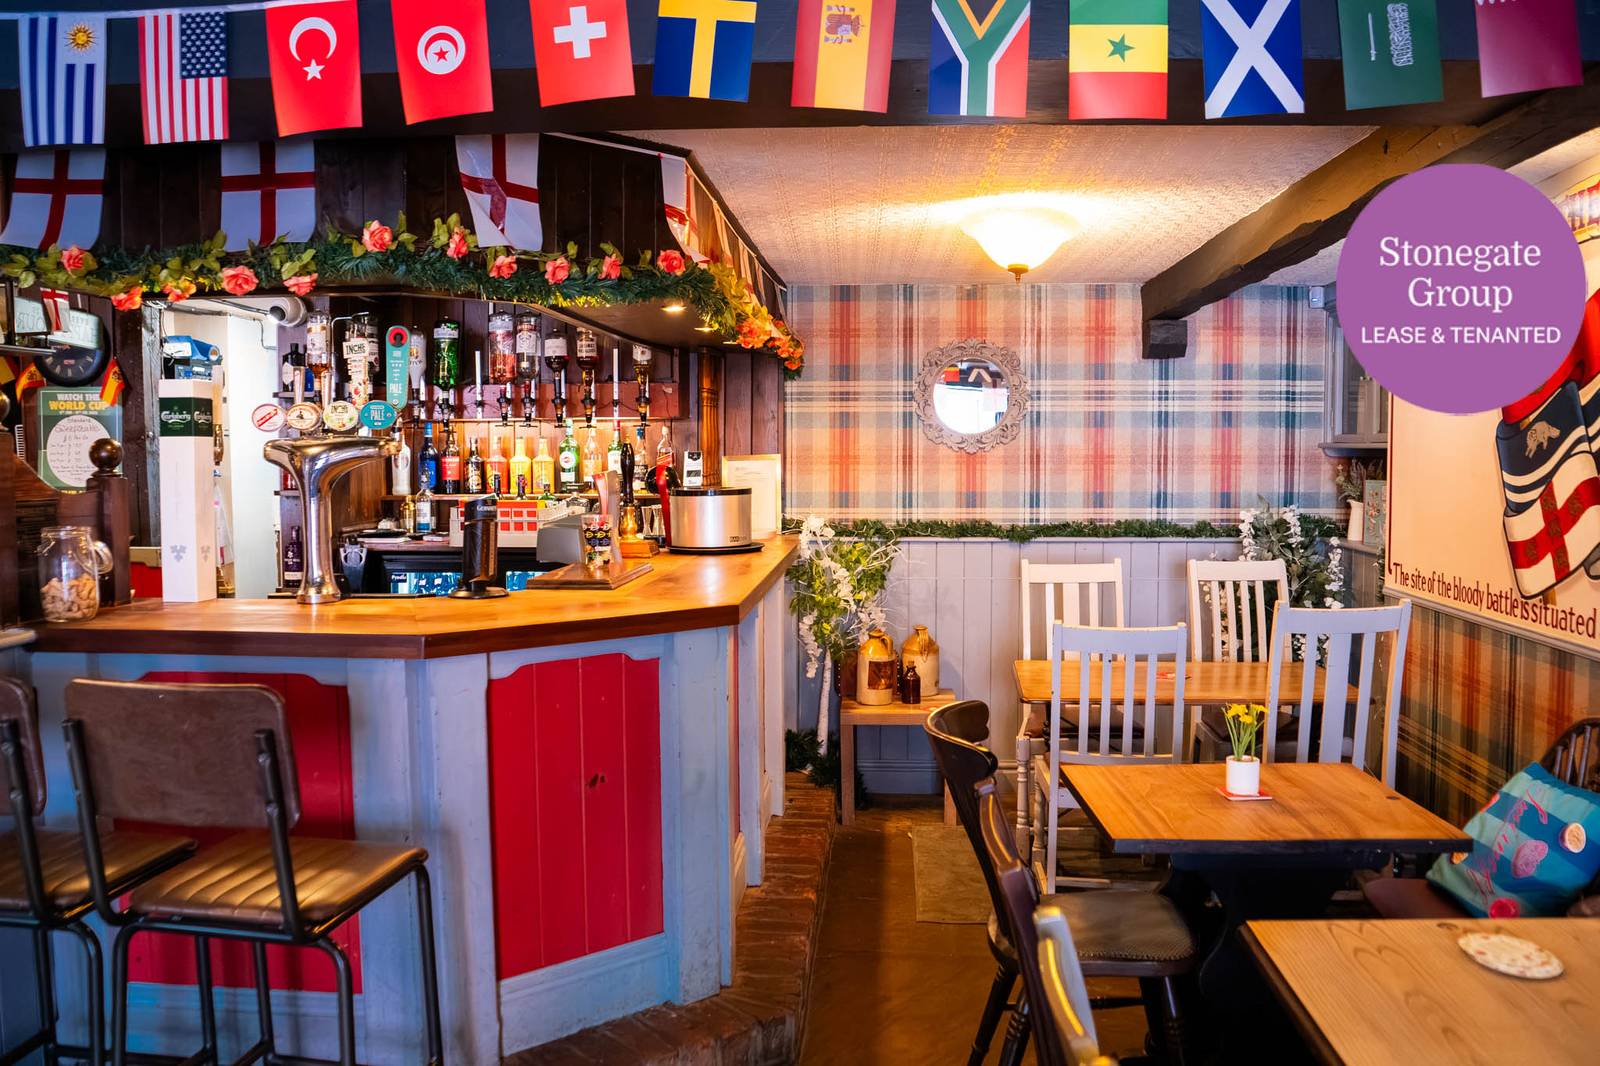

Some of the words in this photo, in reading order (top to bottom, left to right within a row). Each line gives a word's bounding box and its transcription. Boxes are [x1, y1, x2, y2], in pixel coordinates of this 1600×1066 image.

[57, 393, 83, 401] WATCH
[48, 400, 86, 411] WORLD
[161, 410, 191, 421] Carlsberg
[370, 409, 385, 421] PALE
[1393, 562, 1411, 588] The
[1411, 568, 1427, 593] site
[1427, 571, 1438, 594] of
[1438, 574, 1452, 599] the
[1453, 576, 1485, 612] bloody
[1486, 583, 1519, 618] battle
[1520, 601, 1530, 621] is
[1532, 596, 1597, 640] situated
